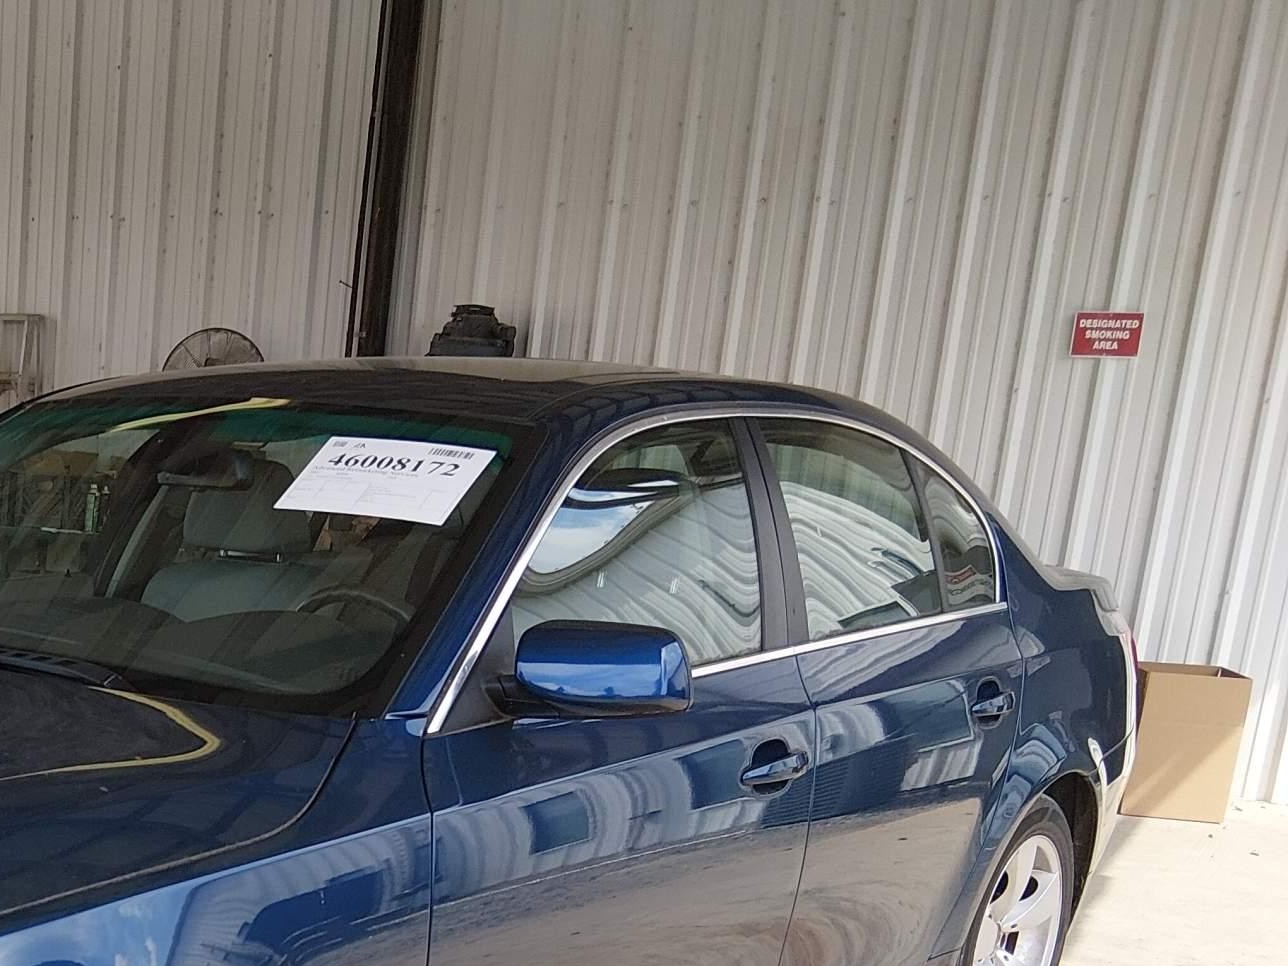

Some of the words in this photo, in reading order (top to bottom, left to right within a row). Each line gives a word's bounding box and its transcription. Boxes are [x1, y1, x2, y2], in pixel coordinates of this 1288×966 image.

[1079, 319, 1140, 328] DESIGNATED
[1085, 330, 1130, 339] SMOKING
[1093, 341, 1118, 349] AREA
[327, 453, 462, 478] 46008172
